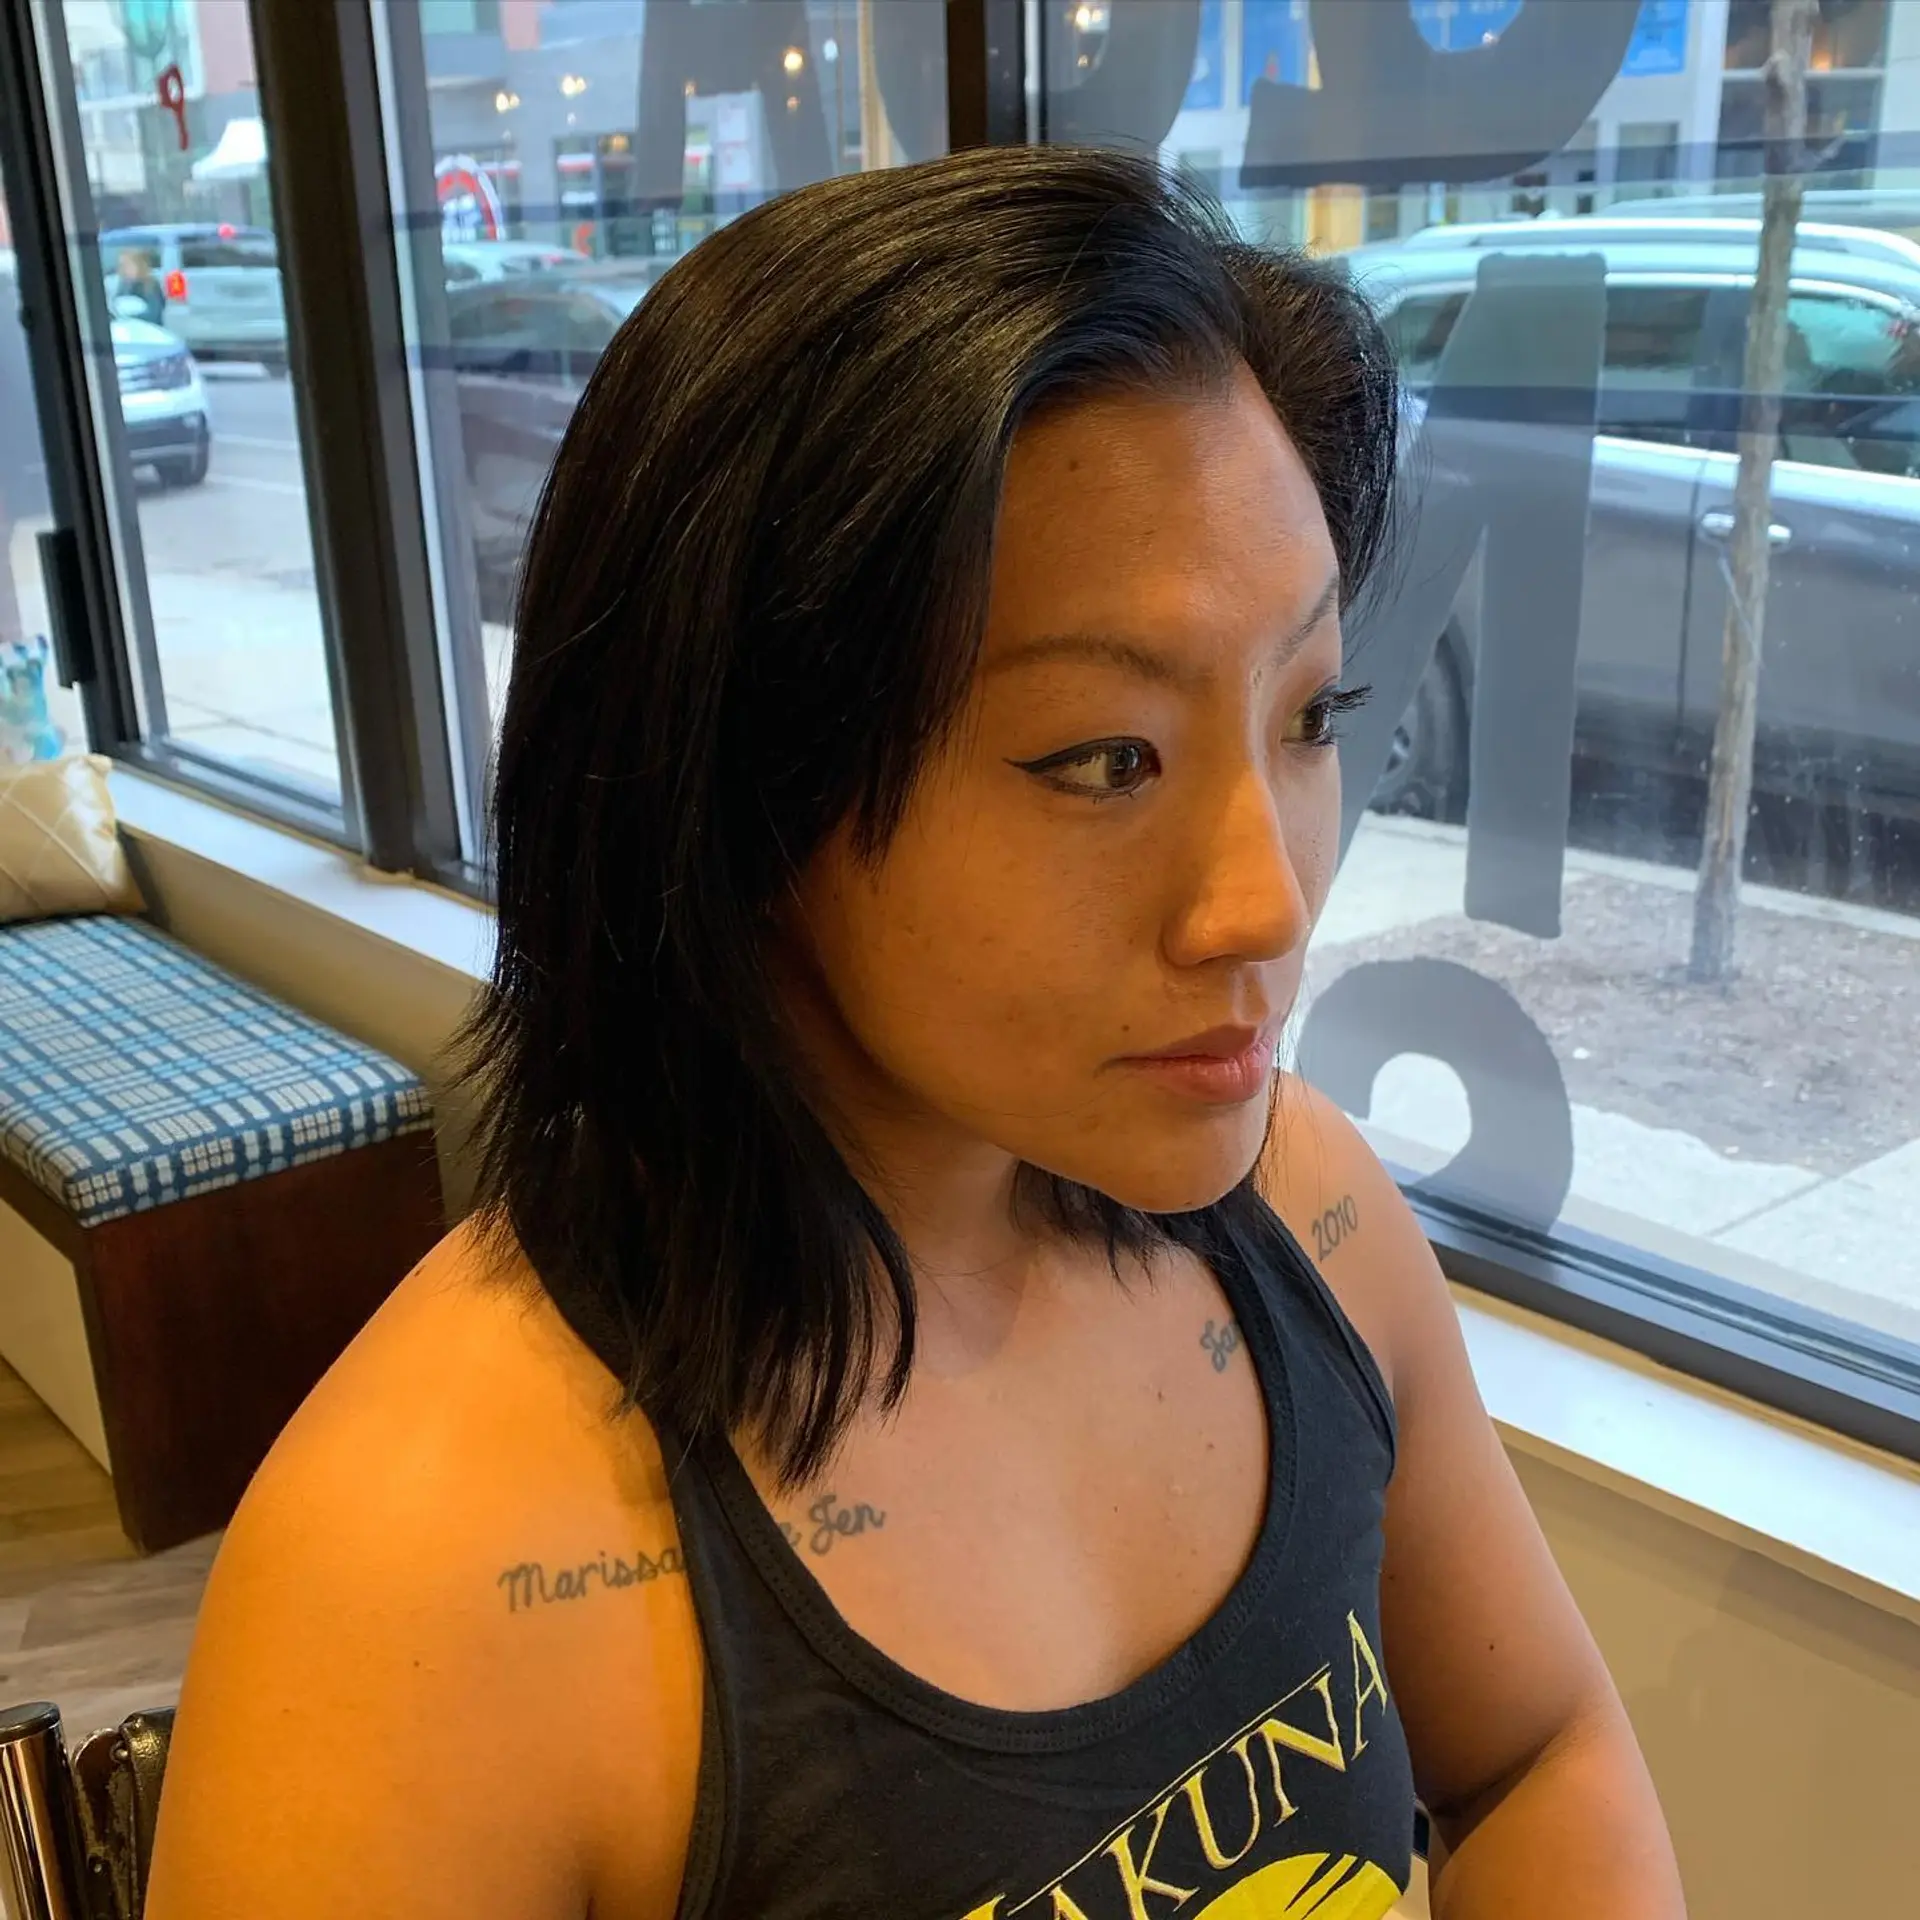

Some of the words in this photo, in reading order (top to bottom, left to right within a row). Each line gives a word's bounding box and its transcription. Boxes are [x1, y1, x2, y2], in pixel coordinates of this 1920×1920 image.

[1310, 1194, 1359, 1262] 2010
[498, 1549, 685, 1612] Marissa
[807, 1494, 887, 1556] Jen
